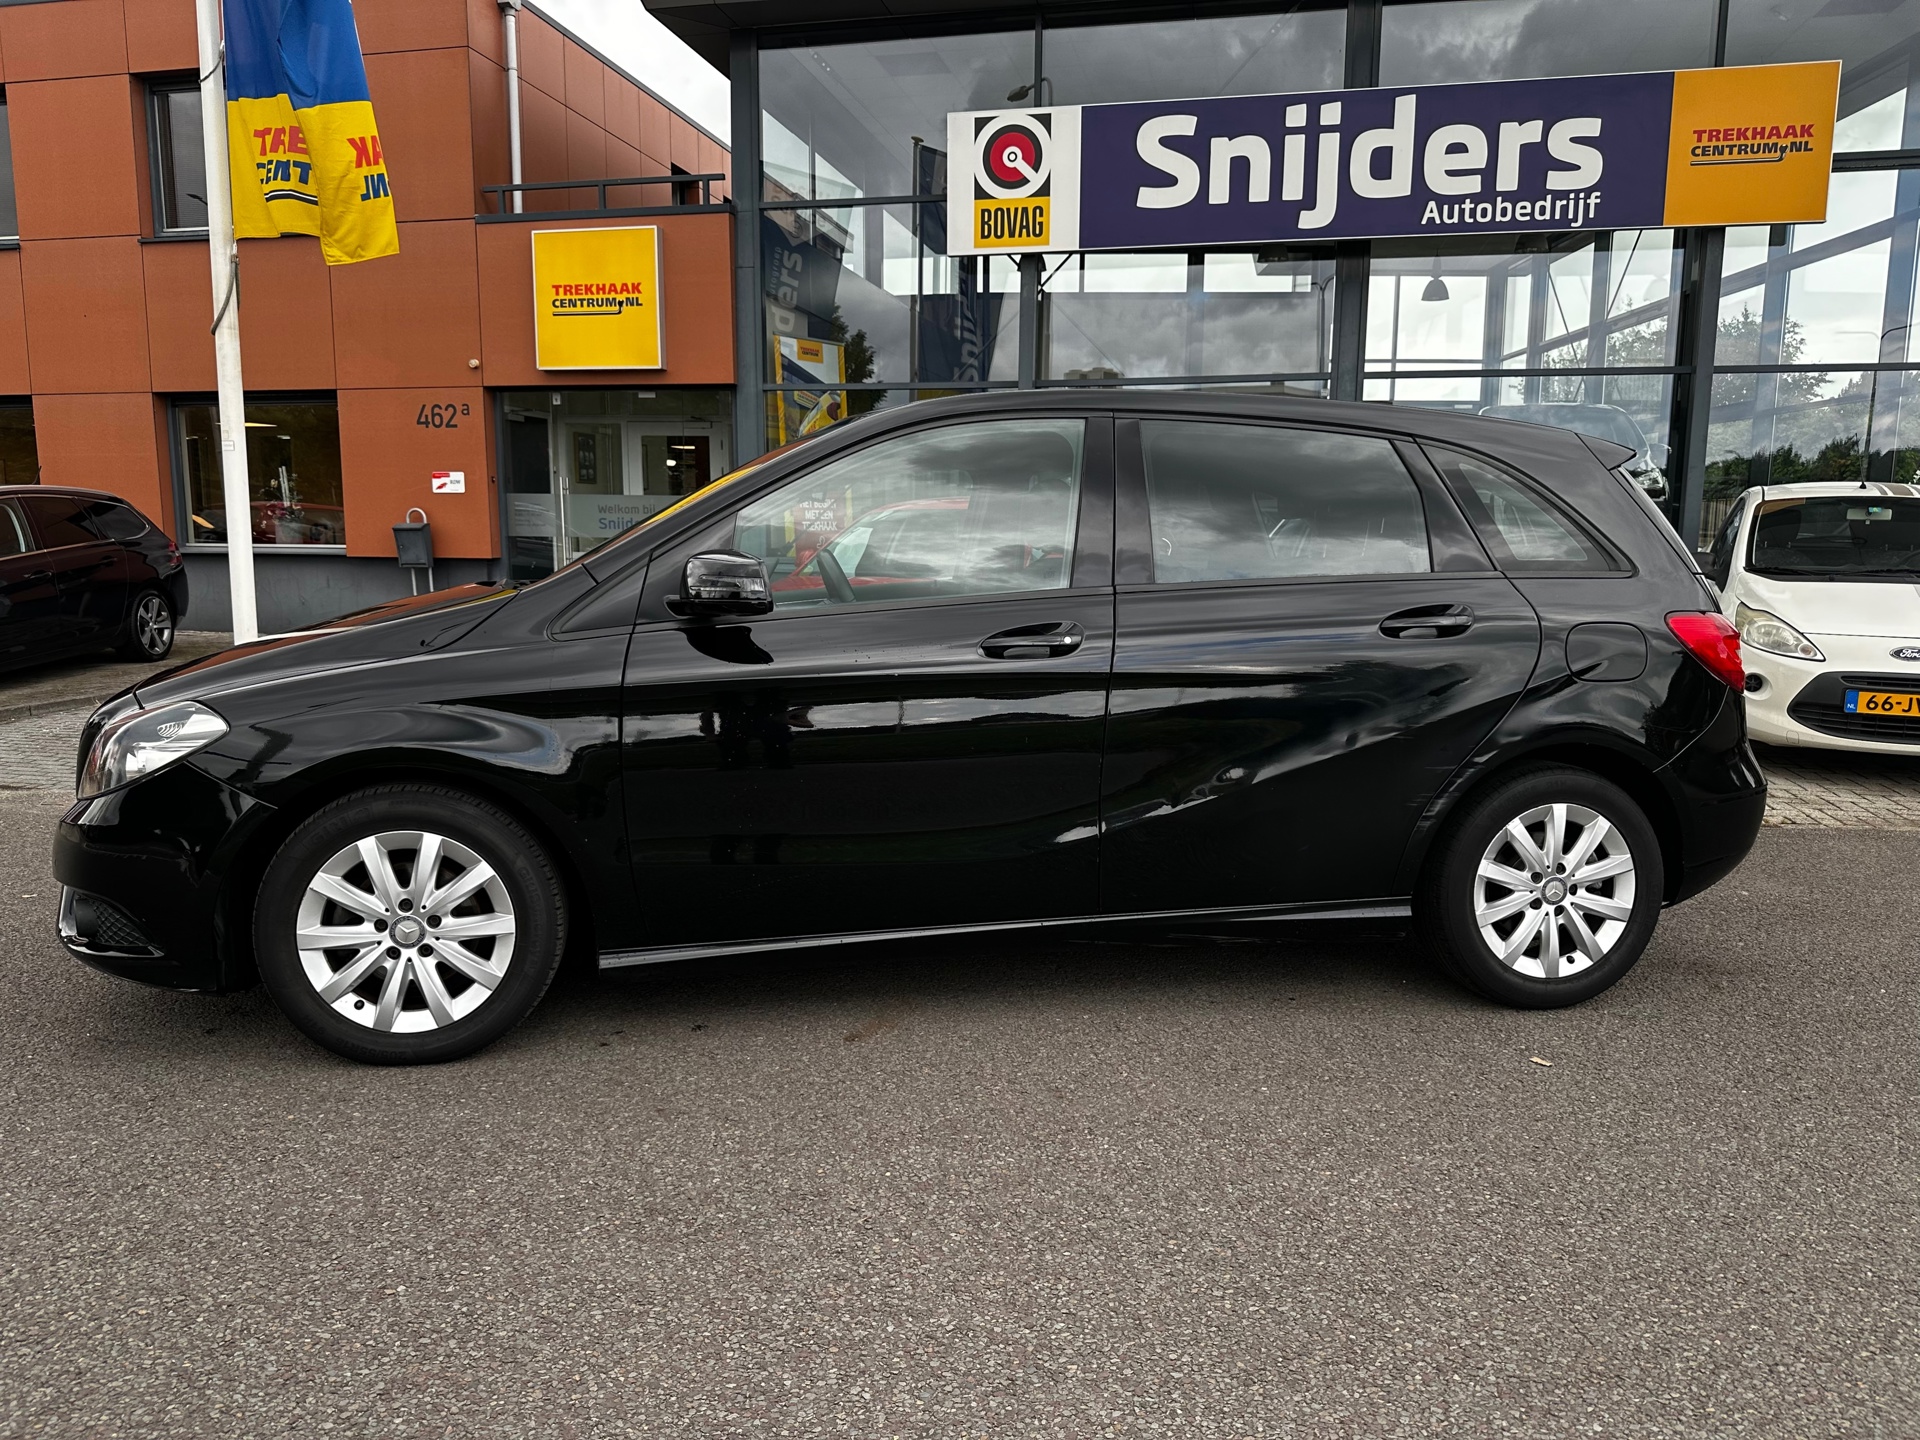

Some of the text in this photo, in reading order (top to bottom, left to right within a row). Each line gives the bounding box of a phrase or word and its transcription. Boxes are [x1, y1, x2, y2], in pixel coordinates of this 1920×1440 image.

[1692, 123, 1816, 144] TREKHAAK
[1136, 94, 1604, 230] Snijders
[980, 205, 1044, 240] BOVAG
[1420, 191, 1602, 228] Autobedrijf
[551, 282, 643, 297] TREKHAAK
[597, 504, 656, 516] Welkom bij
